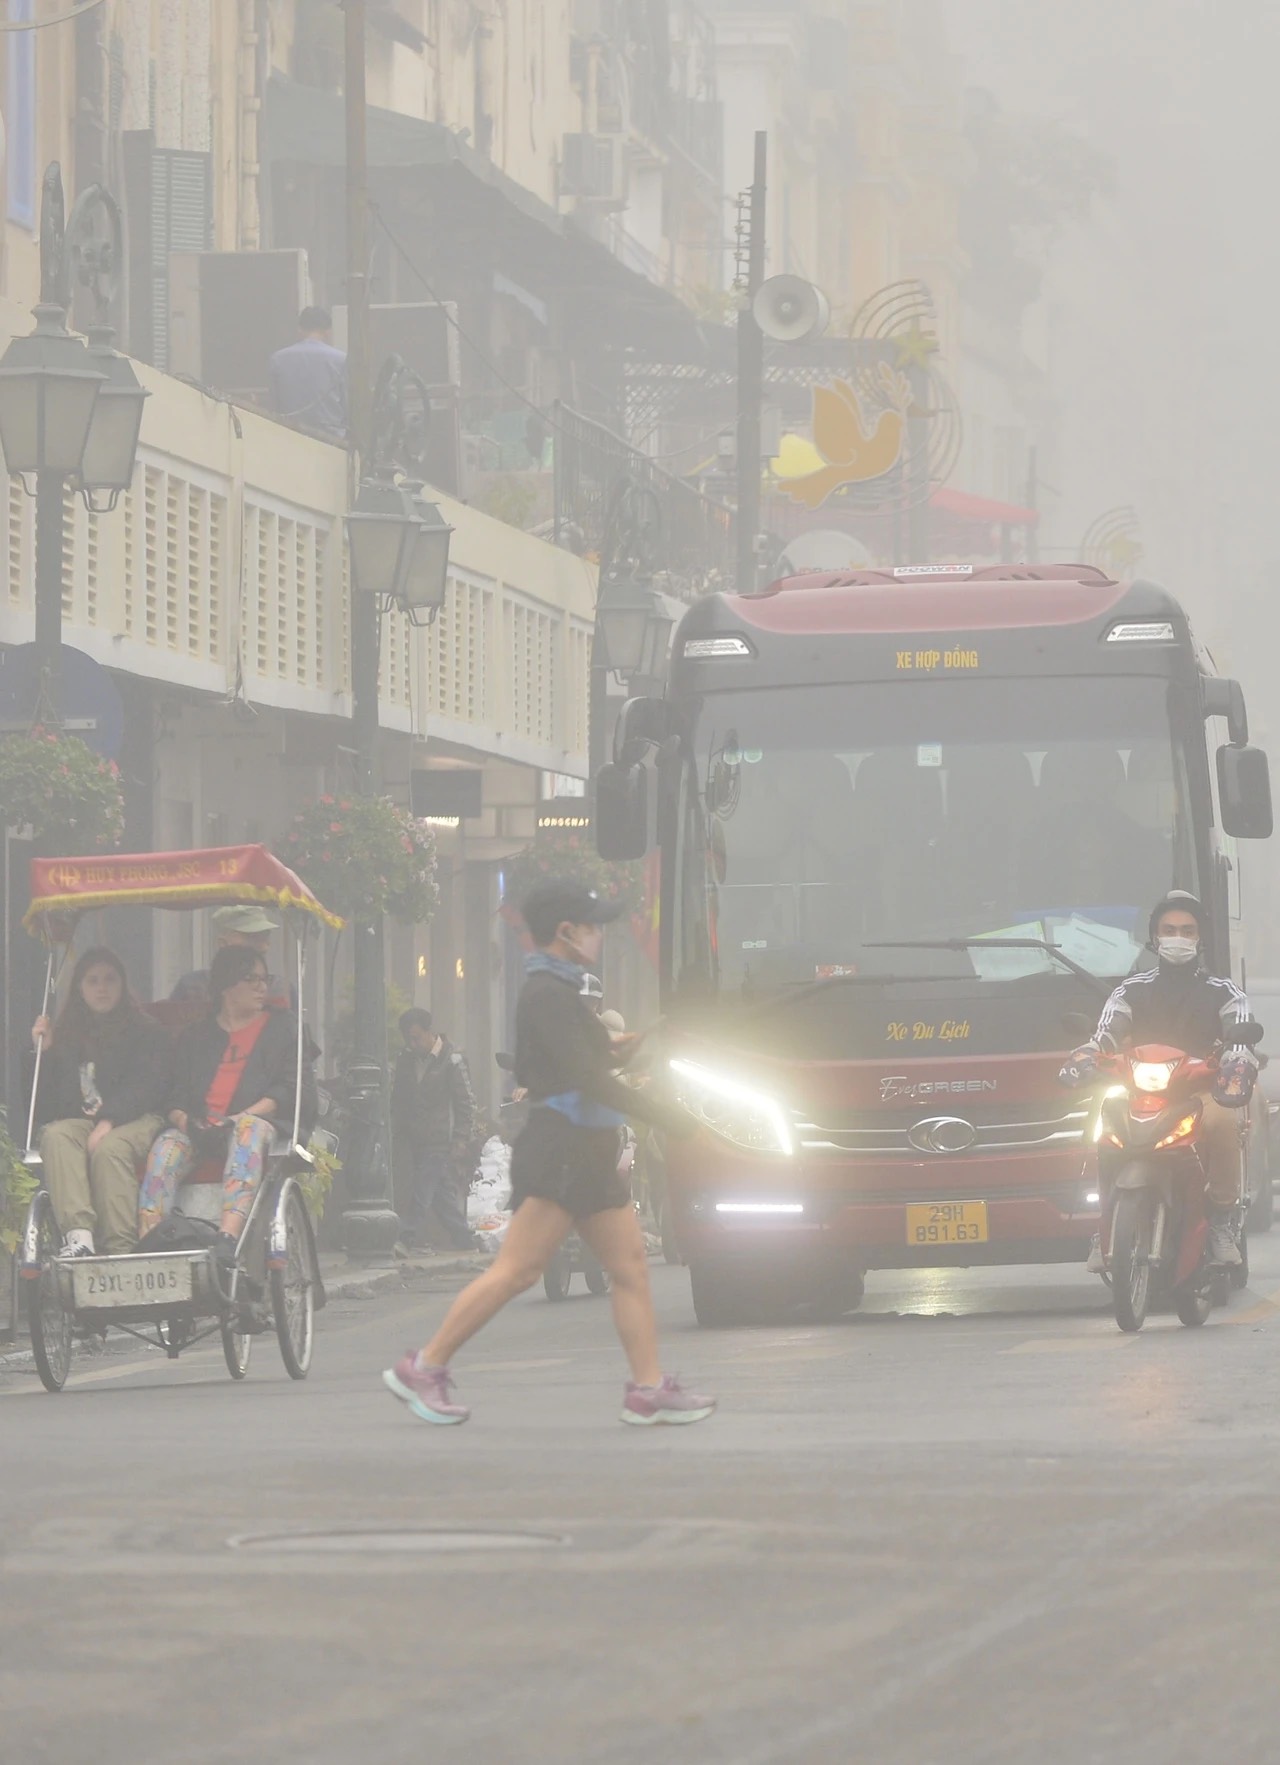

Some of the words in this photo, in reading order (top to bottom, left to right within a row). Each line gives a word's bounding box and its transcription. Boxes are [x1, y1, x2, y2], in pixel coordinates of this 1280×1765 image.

[896, 651, 912, 669] XE
[915, 649, 941, 672] HỢP
[944, 643, 979, 669] ĐỒNG
[85, 865, 116, 883] HUY
[218, 857, 240, 877] 13
[886, 1022, 908, 1040] Xe
[912, 1021, 935, 1041] Du
[938, 1019, 971, 1043] Lịch
[928, 1205, 964, 1222] 29H
[915, 1223, 979, 1242] 891.63
